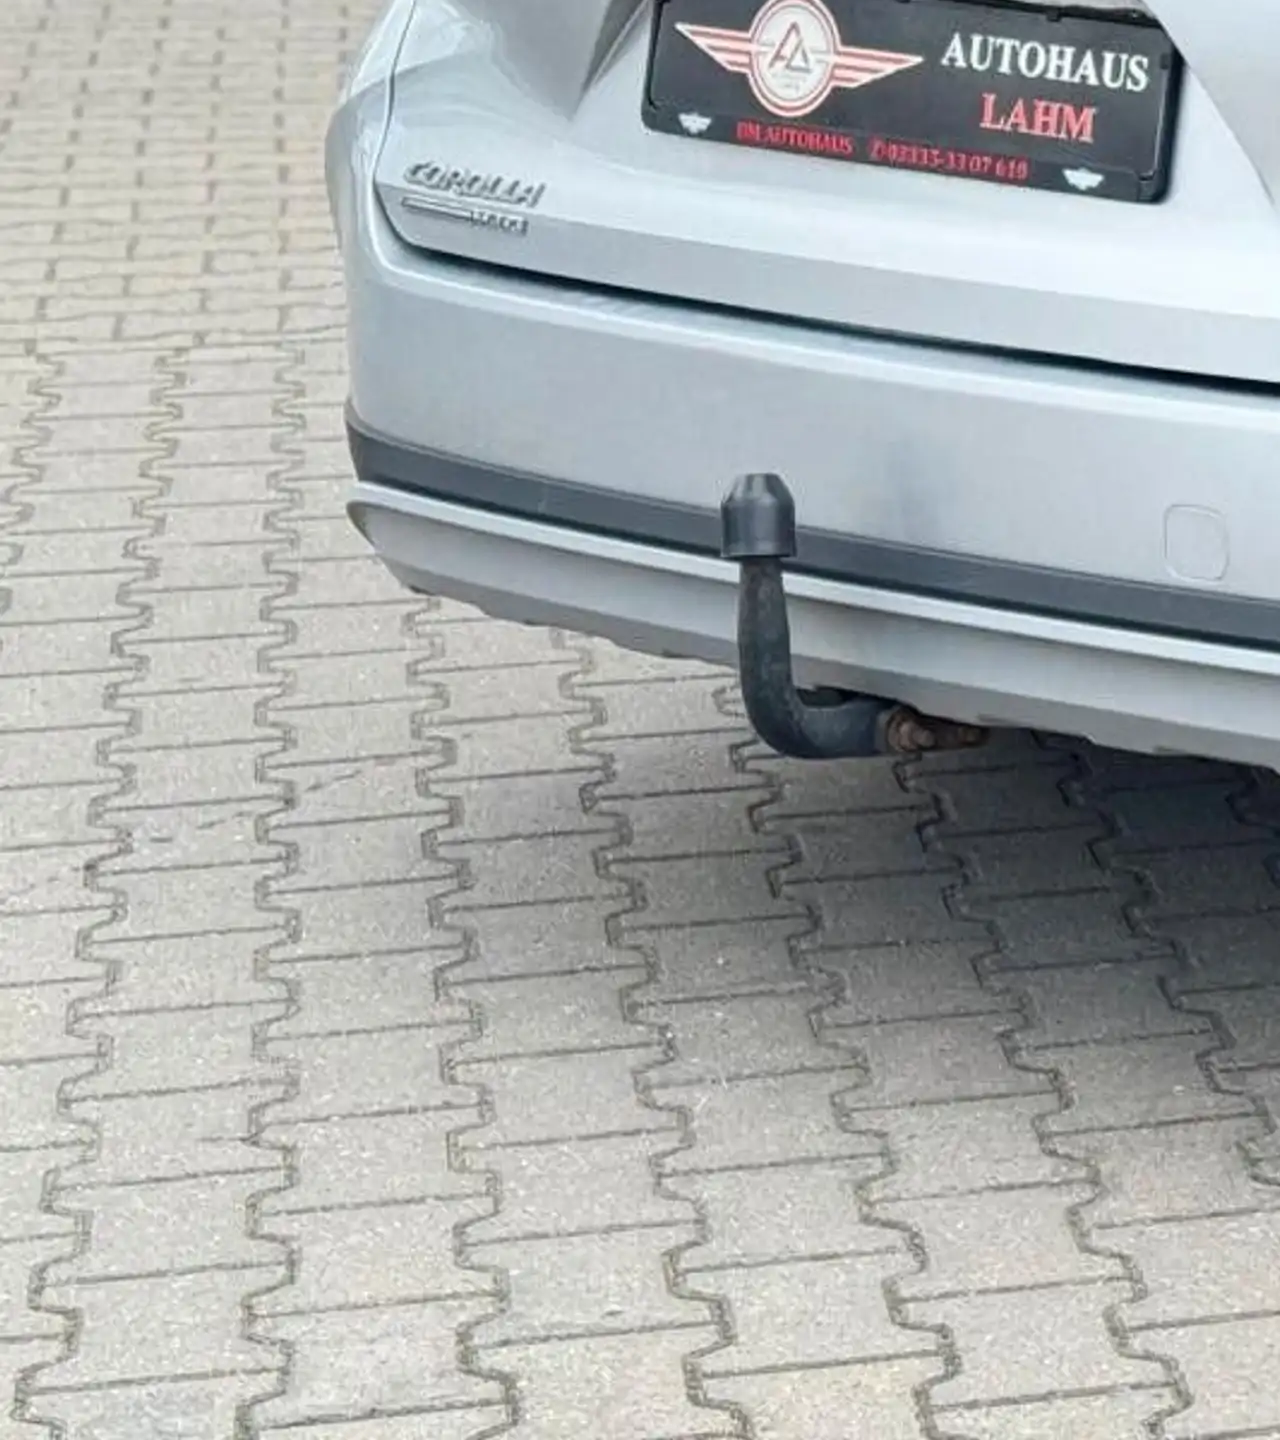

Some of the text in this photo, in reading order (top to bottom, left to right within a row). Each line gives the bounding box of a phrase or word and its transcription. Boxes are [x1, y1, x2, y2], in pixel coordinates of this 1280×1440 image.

[941, 32, 1150, 92] AUTOHAUS
[979, 92, 1097, 143] LAHM
[402, 160, 546, 209] COROLLA
